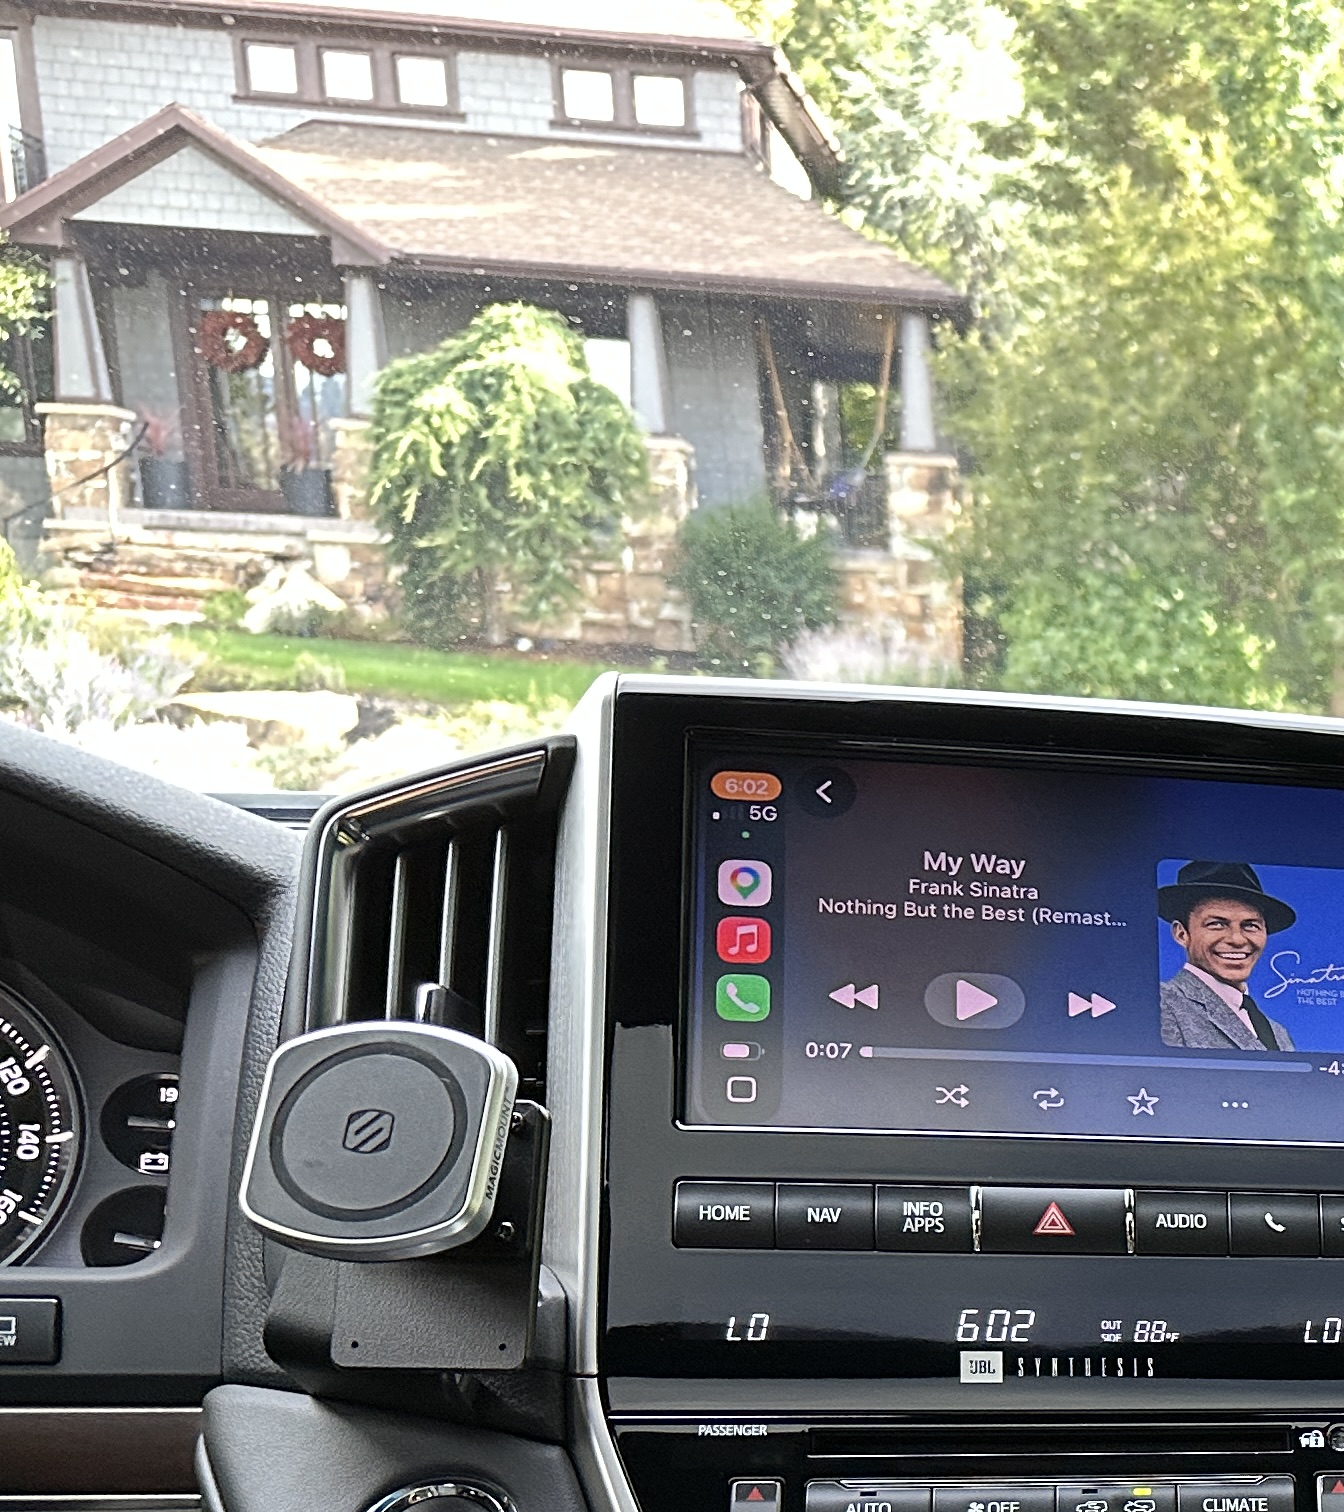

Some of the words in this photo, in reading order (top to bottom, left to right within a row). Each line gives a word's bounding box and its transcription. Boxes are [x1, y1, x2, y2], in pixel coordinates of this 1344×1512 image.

[725, 778, 768, 795] 6:02
[750, 805, 777, 821] 5G
[923, 850, 963, 876] My
[970, 853, 1025, 879] Way
[909, 879, 963, 895] Frank
[969, 881, 1038, 899] Sinatra
[818, 897, 896, 919] Nothing
[903, 901, 937, 917] But
[943, 903, 975, 919] the
[982, 904, 1025, 922] Best
[1296, 988, 1338, 998] NOTHING
[1297, 997, 1314, 1005] THE
[1316, 998, 1337, 1006] BEST
[805, 1041, 852, 1059] 0:07
[0, 1056, 30, 1095] 120
[16, 1123, 41, 1160] 140
[486, 1099, 512, 1201] MAGICMOUNT
[699, 1205, 750, 1221] HOME
[807, 1207, 841, 1223] NAV
[903, 1201, 943, 1217] INFO
[902, 1217, 945, 1233] APPS
[1155, 1214, 1207, 1229] AUDIO
[1101, 1320, 1122, 1330] OUT
[1101, 1333, 1122, 1343] SIDE
[969, 1359, 996, 1375] JBL
[1018, 1357, 1154, 1377] SYNTHESIS
[698, 1424, 768, 1436] PASSENGER
[1203, 1497, 1268, 1512] CLIMATE
